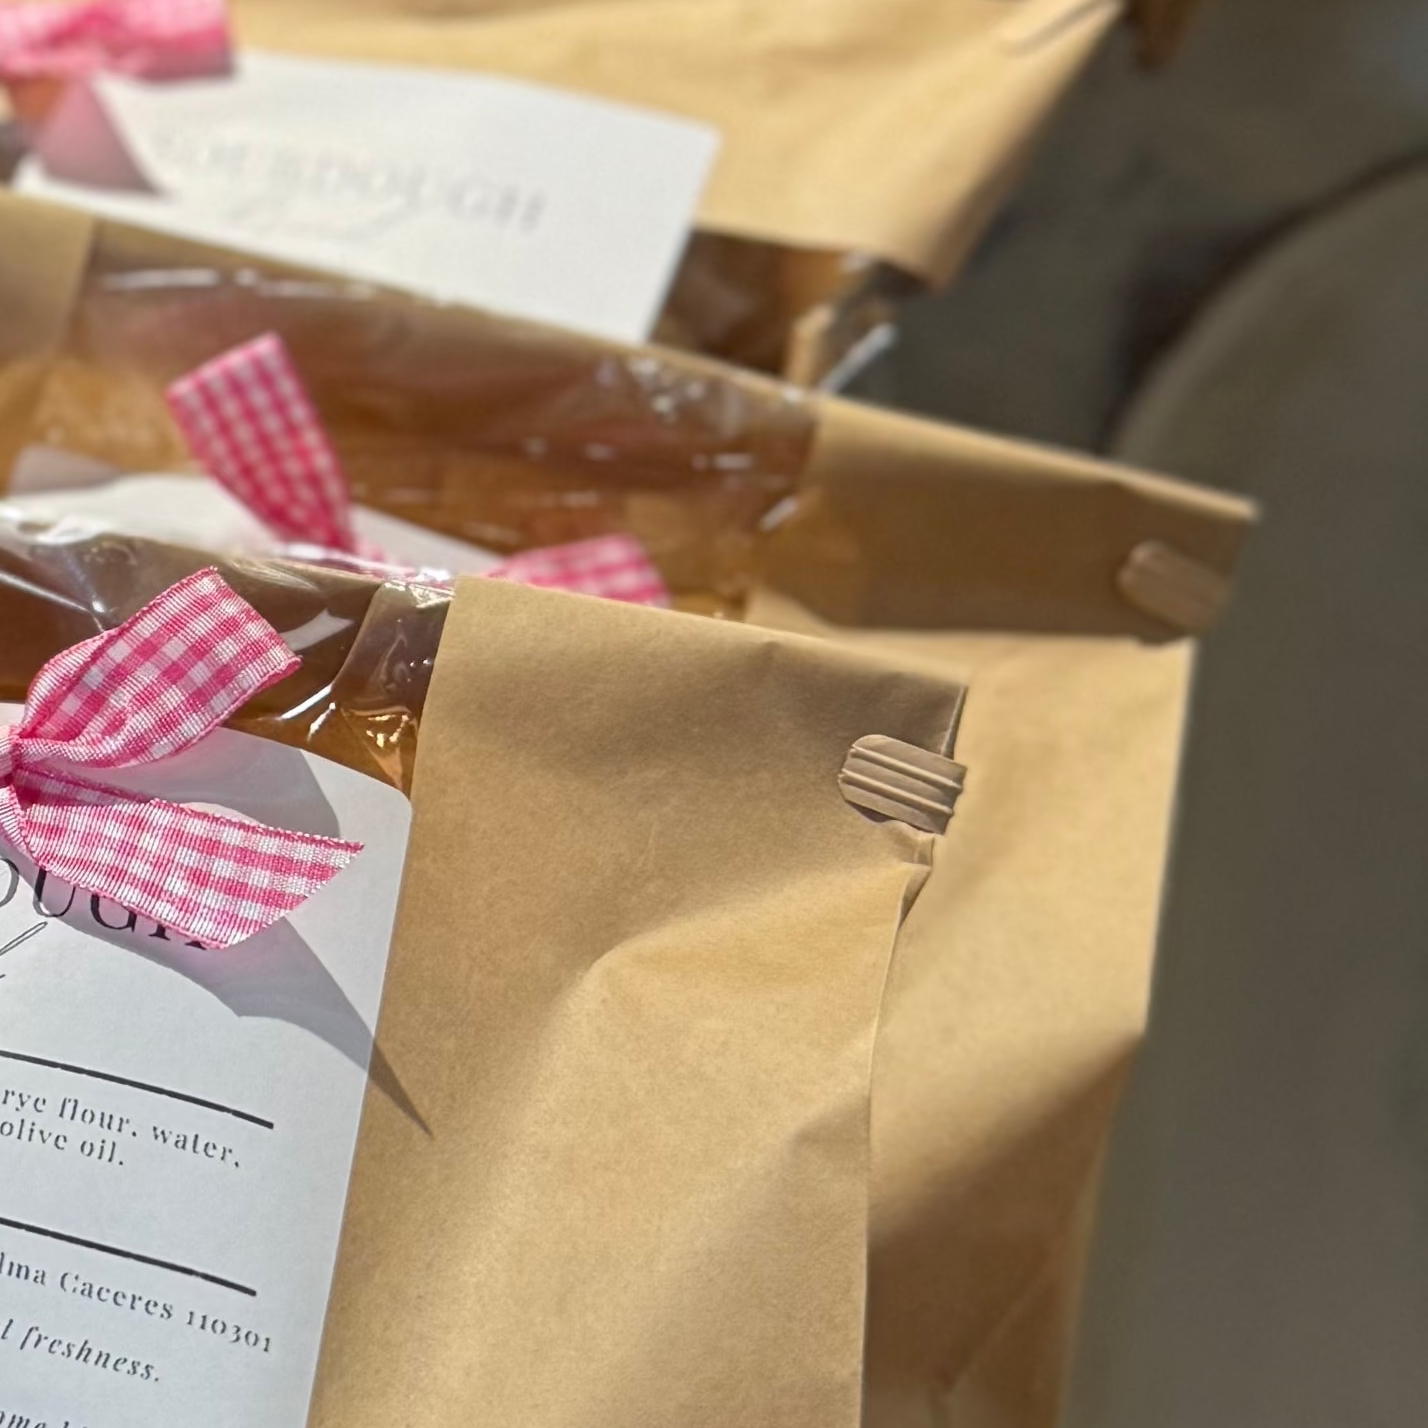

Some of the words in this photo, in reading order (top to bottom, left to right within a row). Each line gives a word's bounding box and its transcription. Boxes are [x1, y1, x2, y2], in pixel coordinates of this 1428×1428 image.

[0, 1117, 68, 1151] olive
[80, 1136, 125, 1166] oil.
[2, 1088, 47, 1114] rye
[58, 1096, 139, 1138] flour,
[152, 1125, 241, 1168] water,
[60, 1273, 174, 1321] Caceres
[187, 1309, 273, 1354] 110301
[19, 1326, 161, 1383] freshness.
